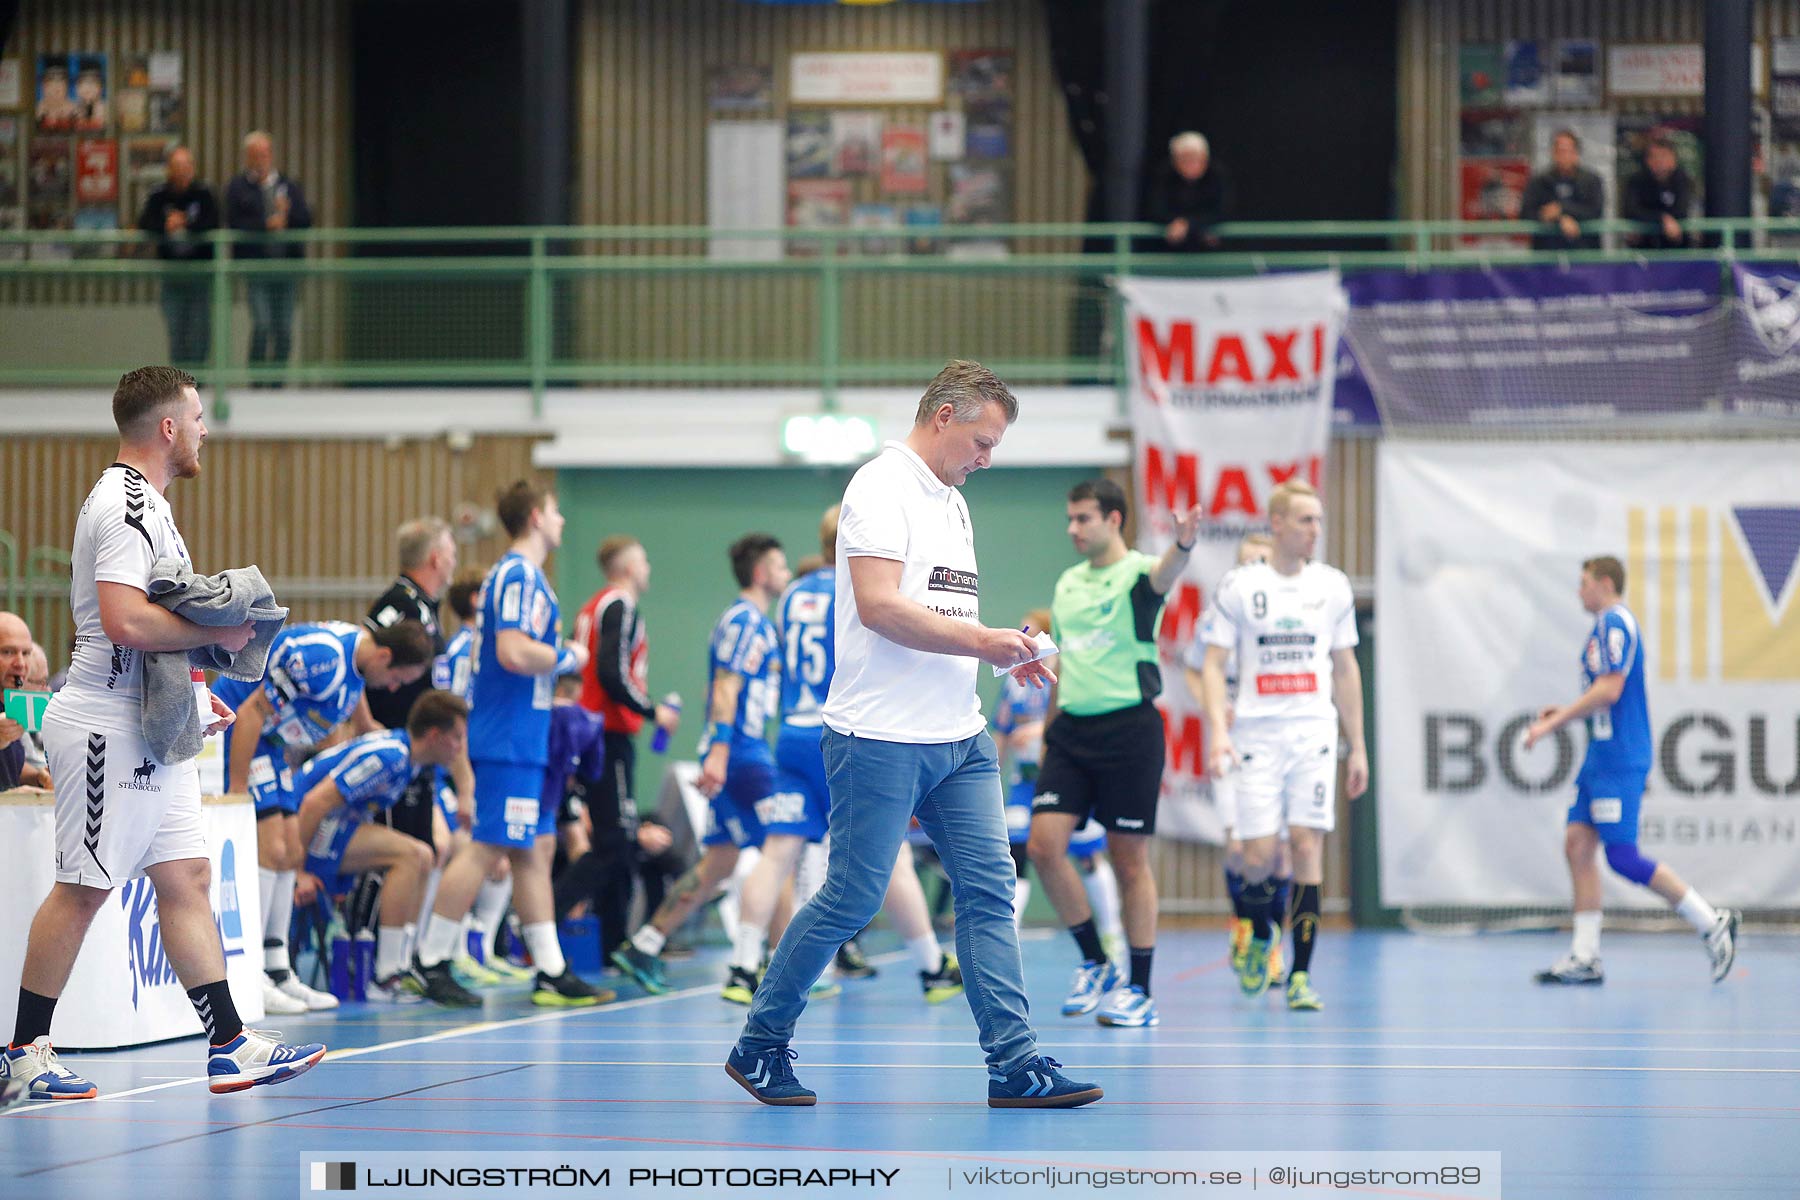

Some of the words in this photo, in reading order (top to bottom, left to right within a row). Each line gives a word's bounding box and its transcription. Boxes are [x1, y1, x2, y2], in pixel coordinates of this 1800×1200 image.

[1252, 591, 1268, 619] 9
[786, 622, 828, 686] 15
[10, 691, 50, 731] T
[118, 781, 162, 793] STENBOCKEN
[1312, 782, 1327, 808] 9
